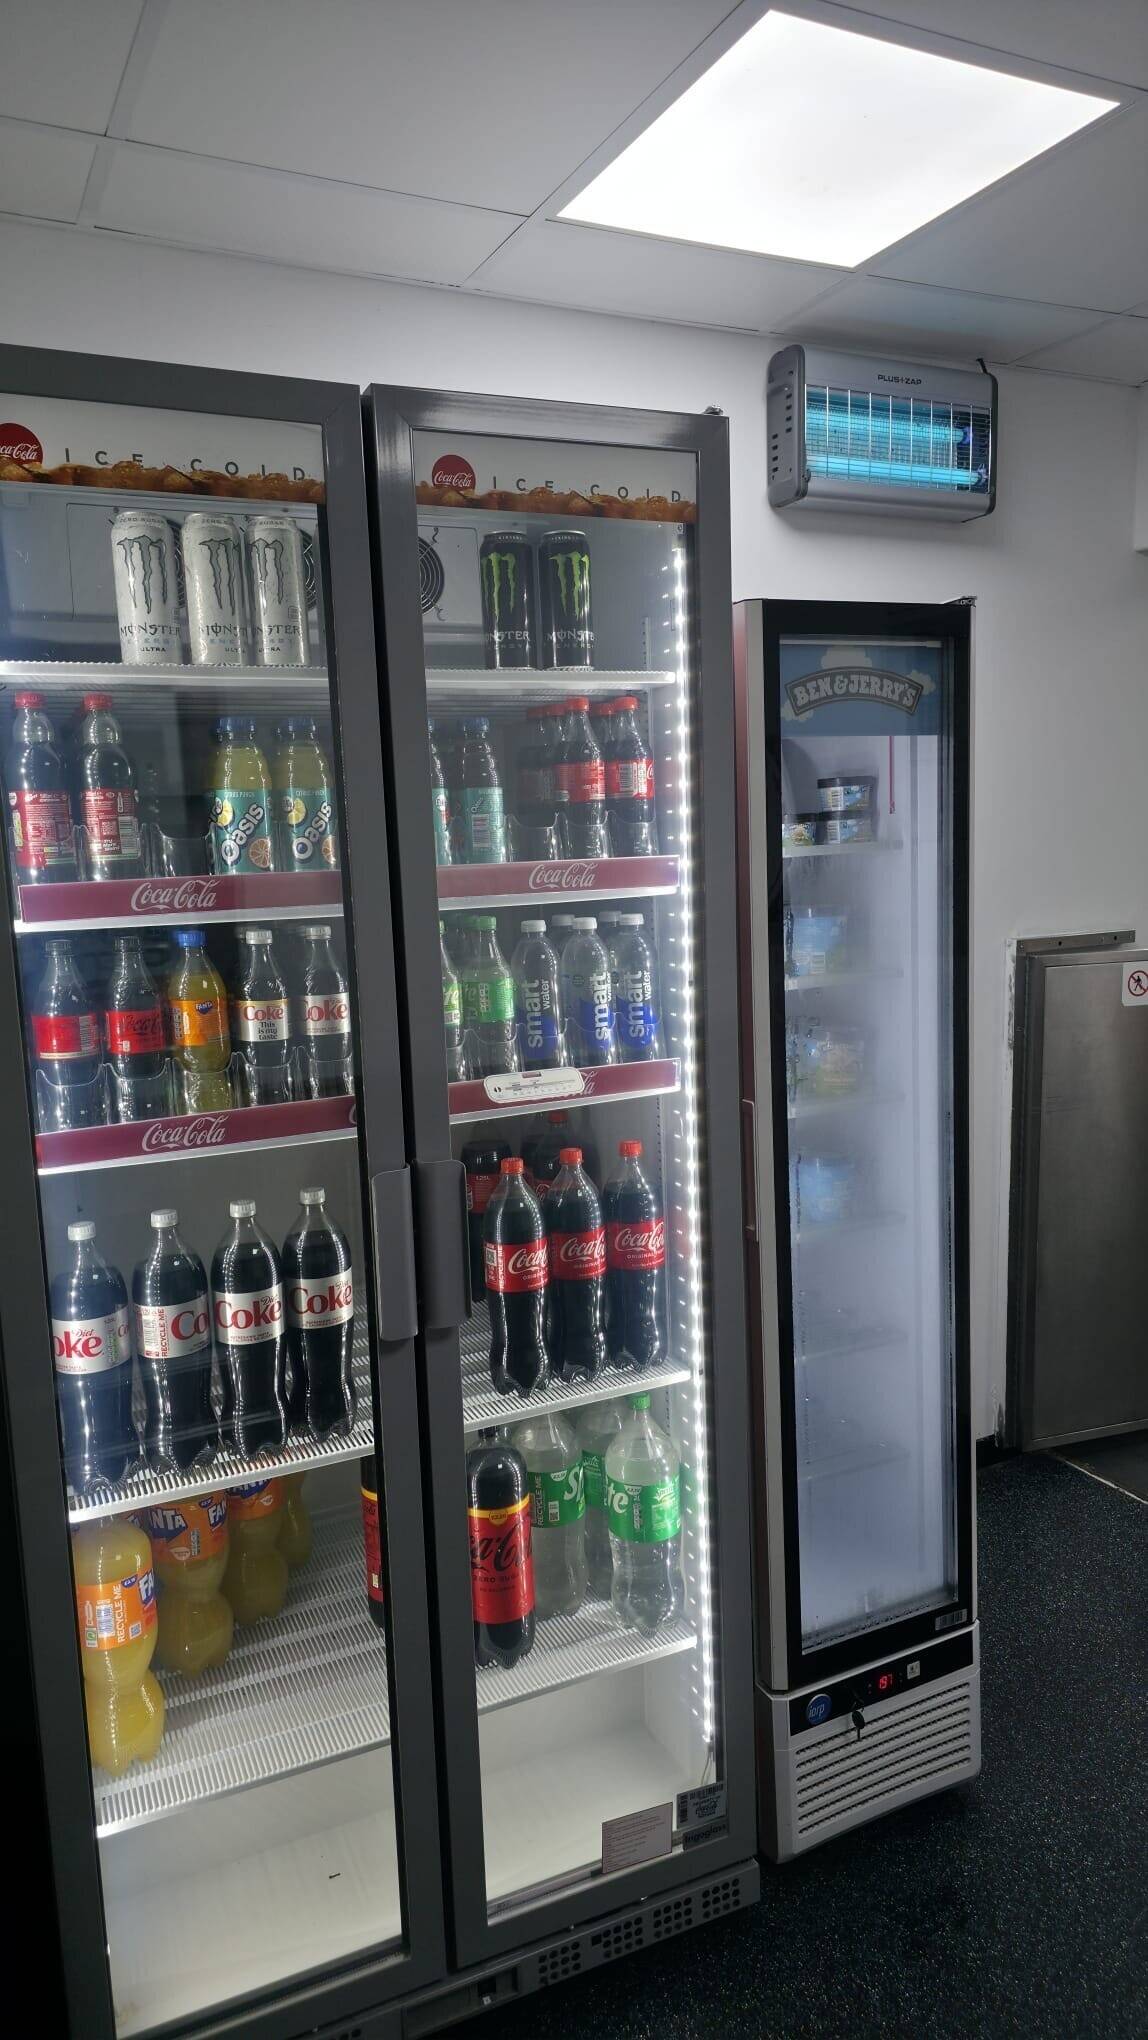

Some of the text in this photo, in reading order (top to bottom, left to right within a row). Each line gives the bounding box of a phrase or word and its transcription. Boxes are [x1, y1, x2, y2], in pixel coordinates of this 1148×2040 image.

[65, 447, 144, 467] ICE
[528, 862, 599, 889] Coca-Cola
[131, 880, 217, 911] Coca-Cola
[243, 1005, 284, 1021] Coke
[522, 979, 543, 1048] smart
[624, 970, 645, 1038] smart
[142, 1113, 229, 1151] Coca-Cola
[215, 1300, 282, 1330] Coke
[290, 1284, 352, 1315] Coke
[159, 1324, 168, 1358] RECYCLE
[171, 1310, 210, 1341] Co
[53, 1331, 104, 1359] oke
[152, 1509, 187, 1531] NTA
[115, 1600, 126, 1644] RECYCLE
